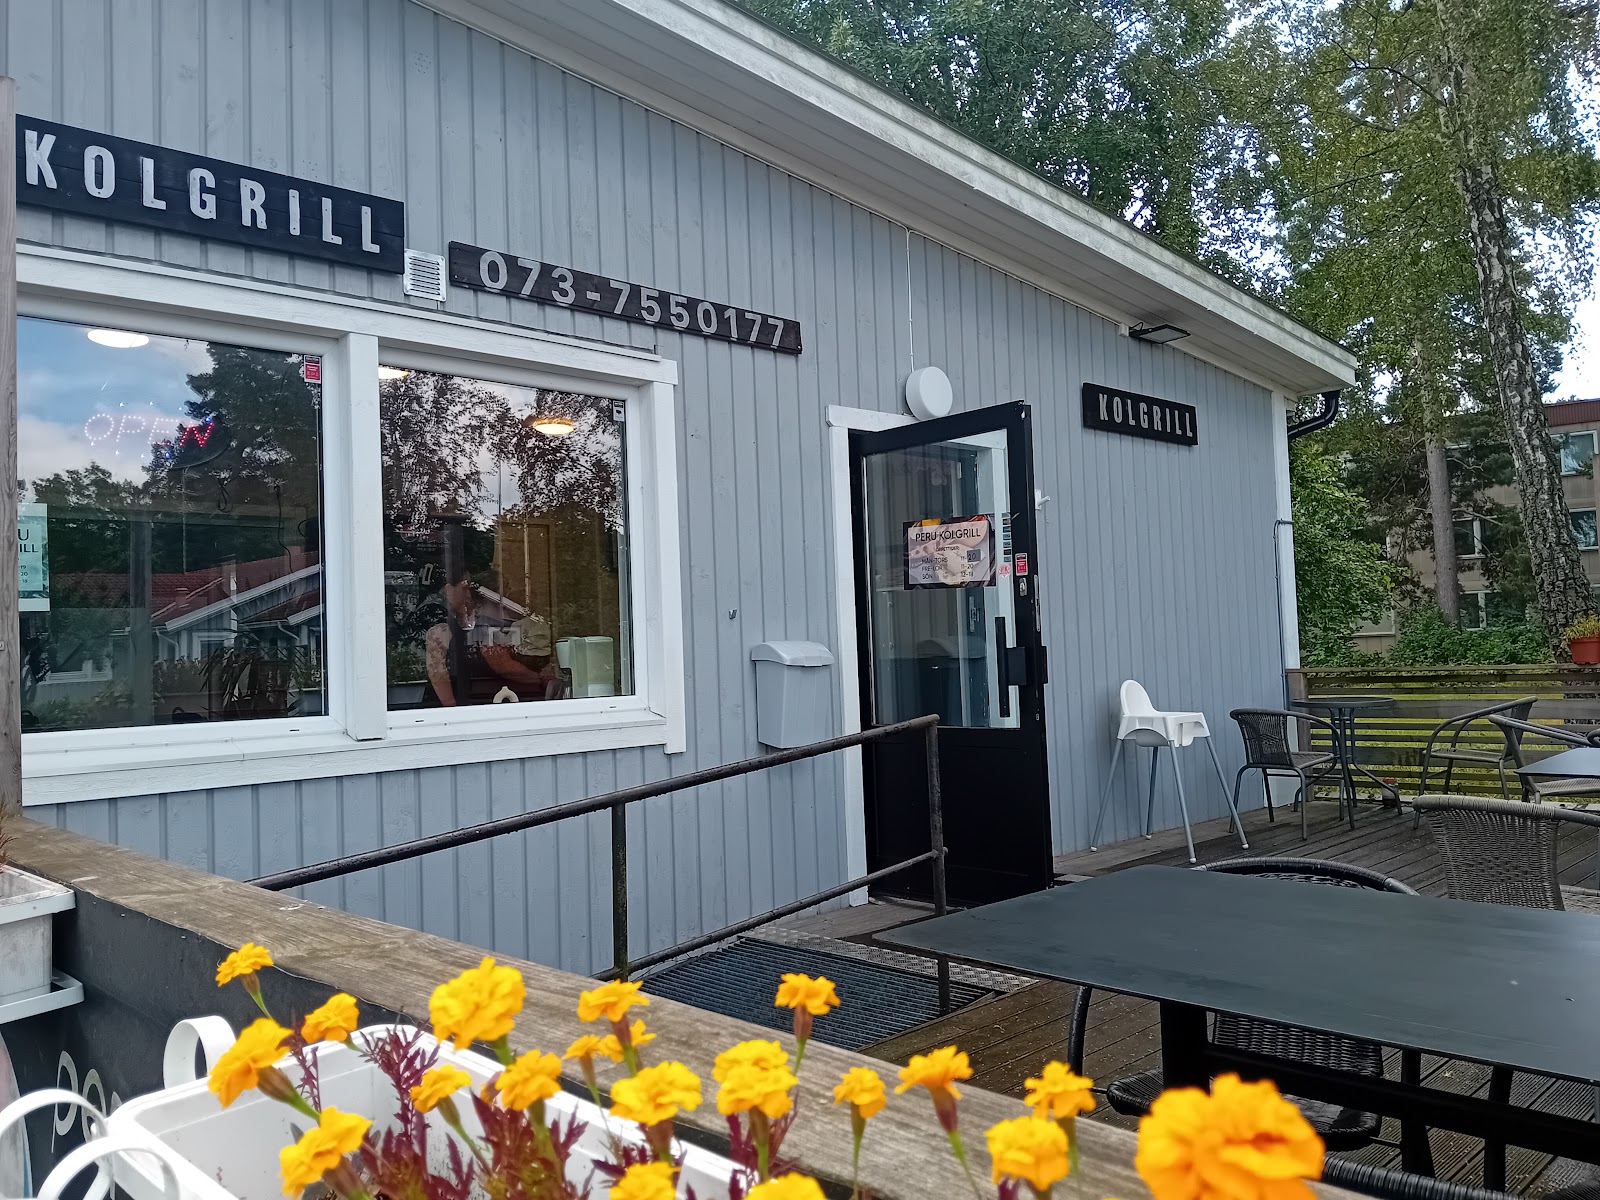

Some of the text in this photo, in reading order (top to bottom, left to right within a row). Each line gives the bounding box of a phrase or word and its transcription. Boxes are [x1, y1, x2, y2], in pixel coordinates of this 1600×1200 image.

[24, 128, 380, 254] KOLGRILL
[479, 250, 785, 348] 073-7550177
[84, 412, 215, 448] OPEN
[1098, 392, 1193, 438] KOLGRILL
[915, 527, 981, 542] PERU KOLGRILL
